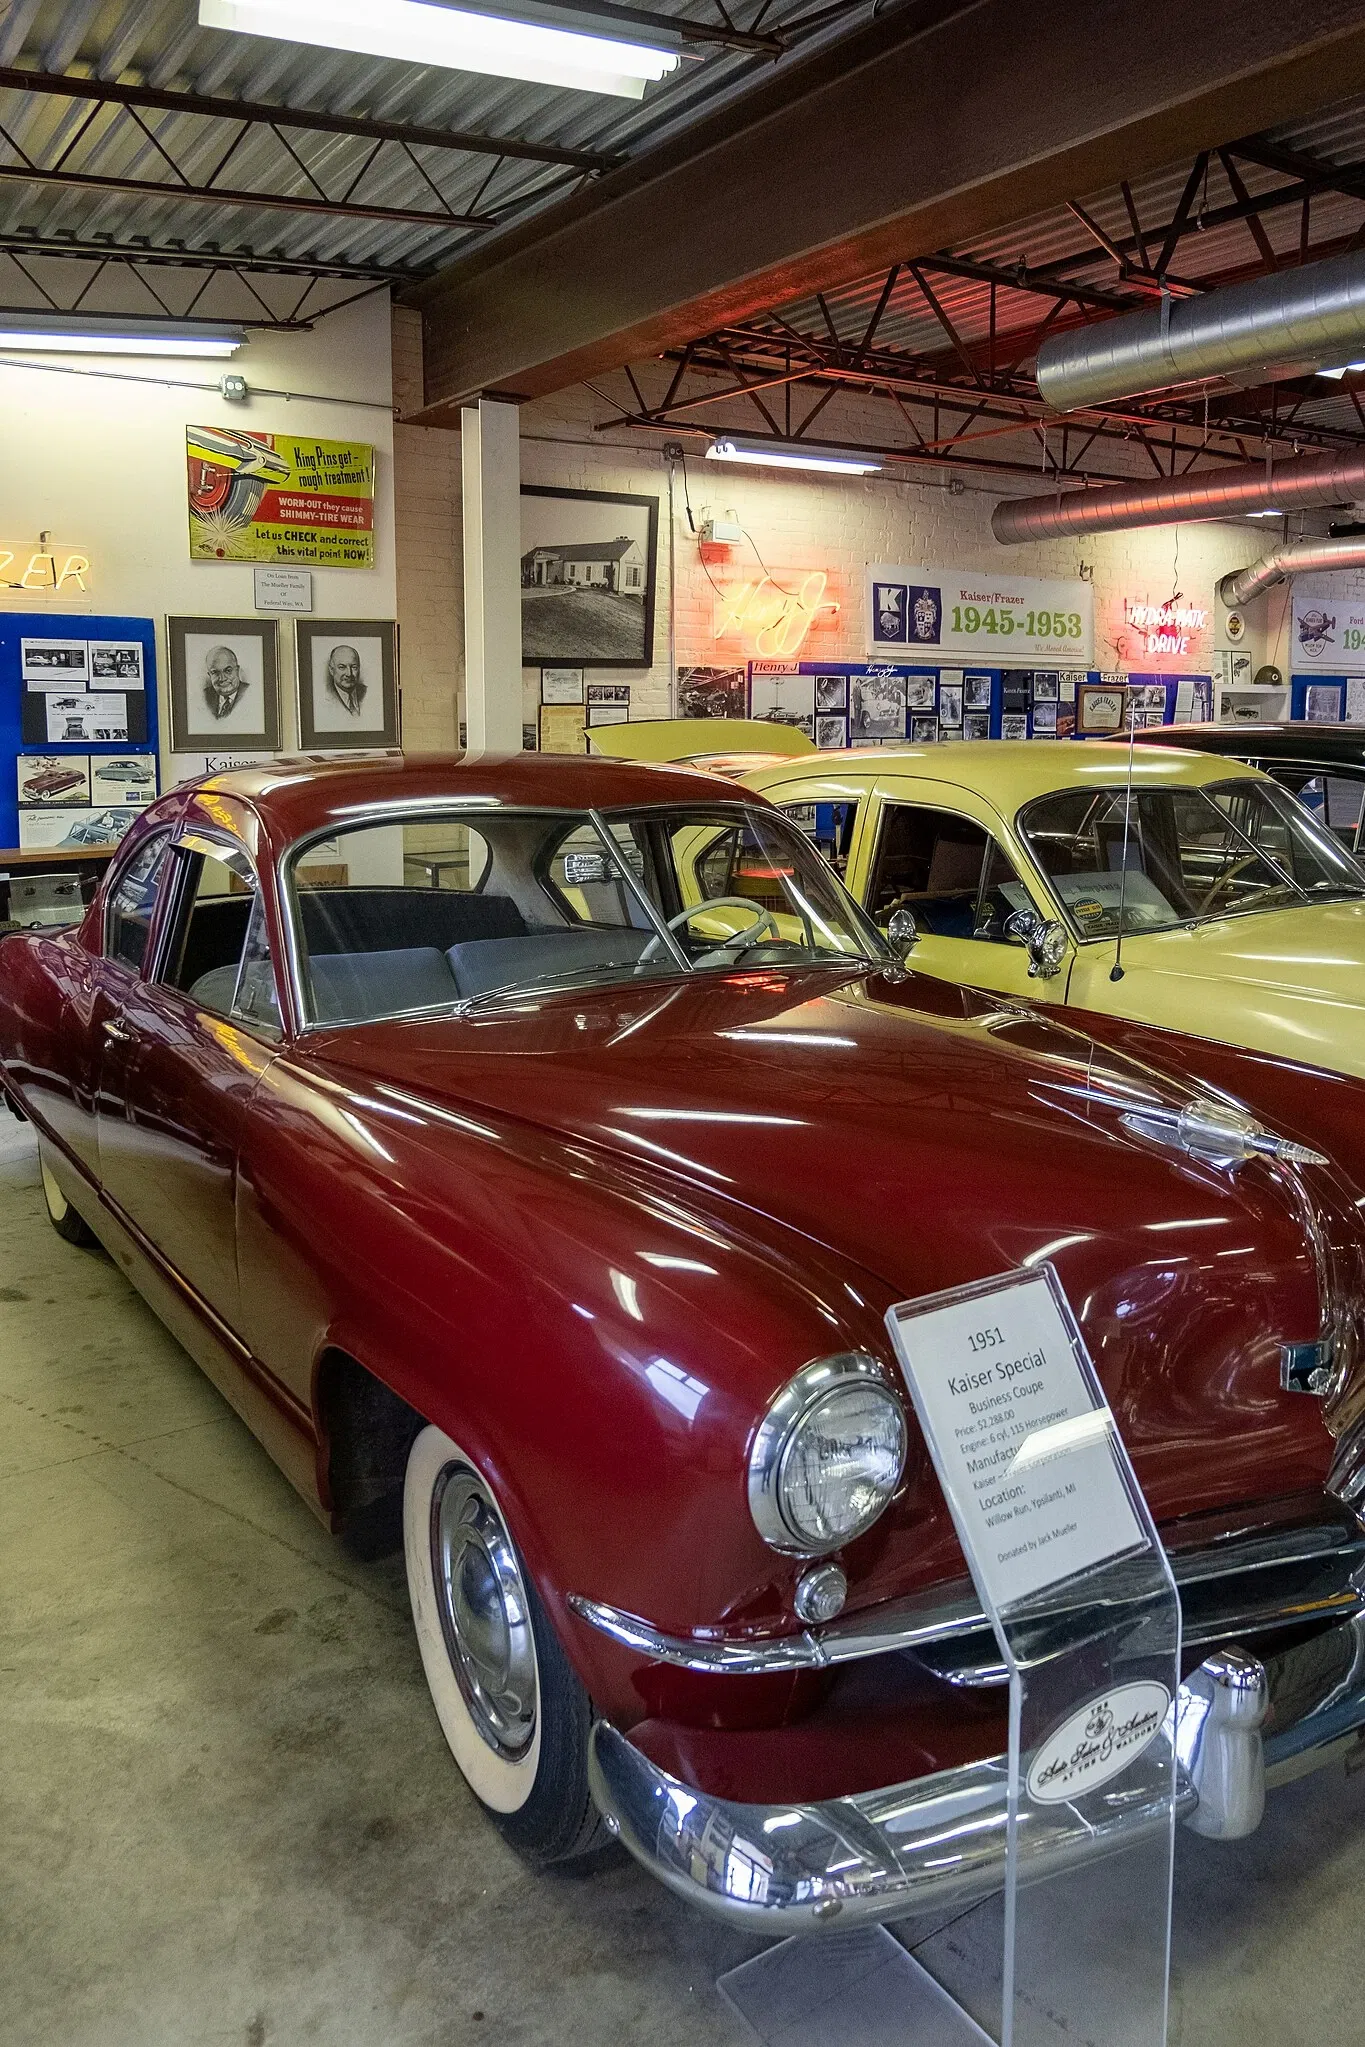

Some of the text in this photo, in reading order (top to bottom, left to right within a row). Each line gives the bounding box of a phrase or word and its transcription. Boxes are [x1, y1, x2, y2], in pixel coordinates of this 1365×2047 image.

[294, 447, 316, 471] King
[316, 446, 338, 466] Pins
[338, 450, 353, 469] get
[299, 471, 323, 491] rough
[278, 497, 364, 513] WORN-OUT they cause
[280, 509, 365, 525] SHIMMY-TIRE WEAR
[256, 528, 270, 540] Let
[284, 531, 317, 543] CHECK
[320, 535, 337, 544] and
[338, 538, 369, 546] correct
[277, 545, 370, 561] this vital point NOW!
[960, 590, 1025, 605] Kaiser/Frazer
[951, 606, 1082, 638] 1945-1953
[1129, 605, 1208, 628] HYDRA-MATIC
[1349, 616, 1364, 625] Ford
[1148, 634, 1190, 655] DRIVE
[754, 662, 798, 674] Henry J
[1059, 672, 1086, 682] Kaiser
[968, 1327, 1006, 1352] 1951
[948, 1347, 1047, 1396] Kaiser Special
[969, 1379, 1045, 1415] Business Coupe
[954, 1409, 1015, 1438] Price: $2,288.00
[960, 1407, 1068, 1454] Engine: 6 cyl, 115 Horsepower
[973, 1475, 996, 1491] Kaiser
[979, 1484, 1026, 1511] Location:
[985, 1482, 1076, 1528] Willow Run, Ypsilanti, MI
[997, 1522, 1078, 1563] Donated by Jack Mueller
[1091, 1701, 1109, 1715] THE
[1063, 1722, 1158, 1783] AT THE WALDORF
